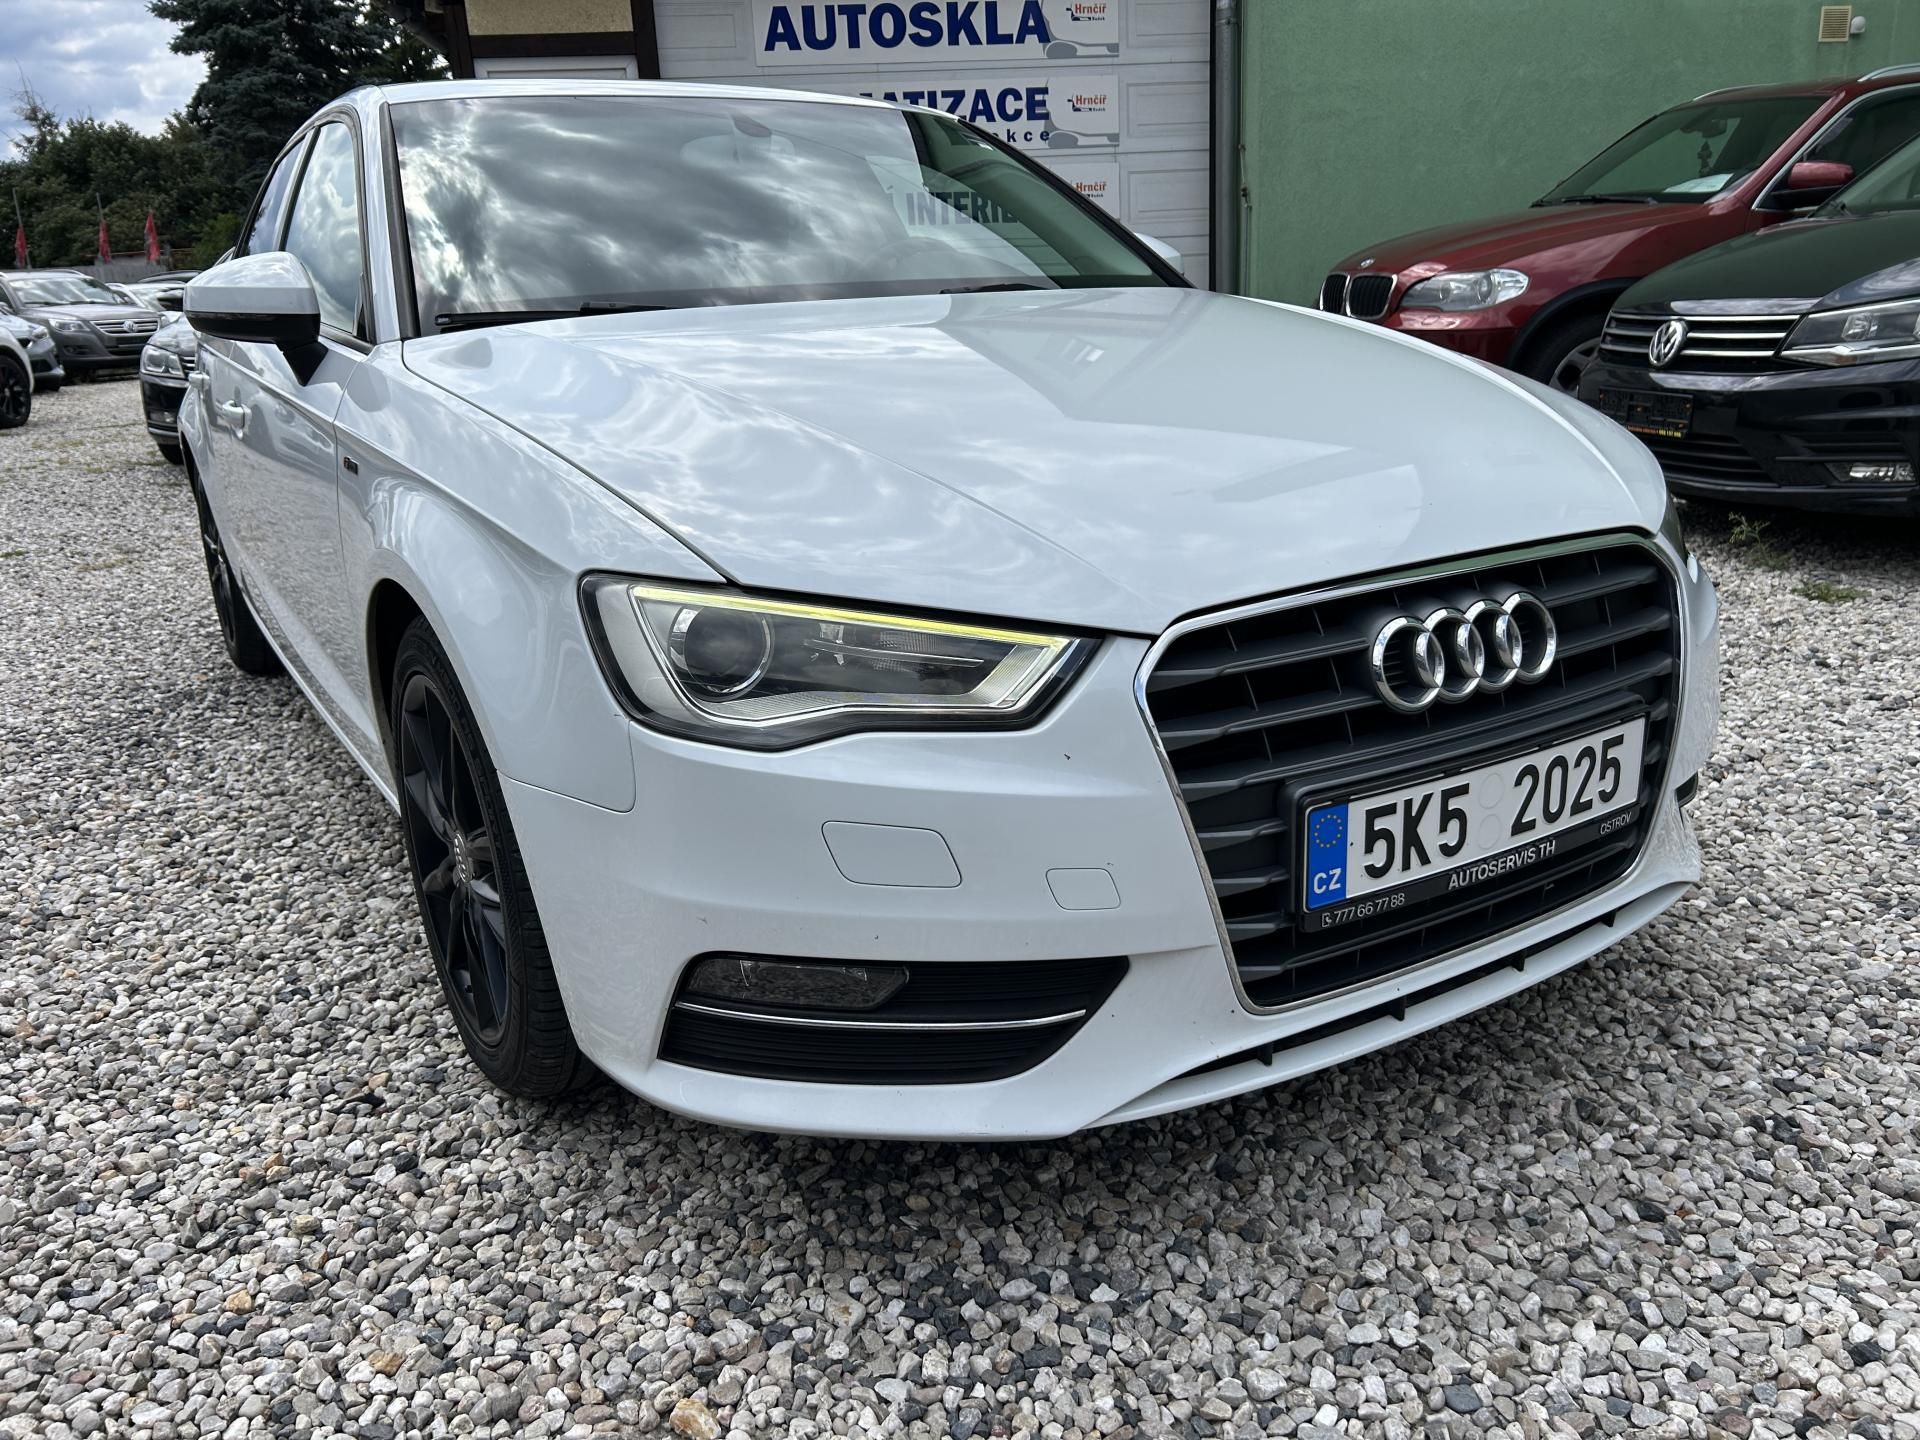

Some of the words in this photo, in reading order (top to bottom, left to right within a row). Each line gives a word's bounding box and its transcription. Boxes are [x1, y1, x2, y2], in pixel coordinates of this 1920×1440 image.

[764, 0, 1051, 51] AUTOSKLA
[1362, 782, 1471, 879] 5K5
[1510, 733, 1626, 837] 2025
[1600, 812, 1632, 836] OSTROV
[1313, 868, 1342, 894] CZ
[1448, 847, 1536, 890] AUTOSERVIS
[1538, 840, 1556, 862] TH
